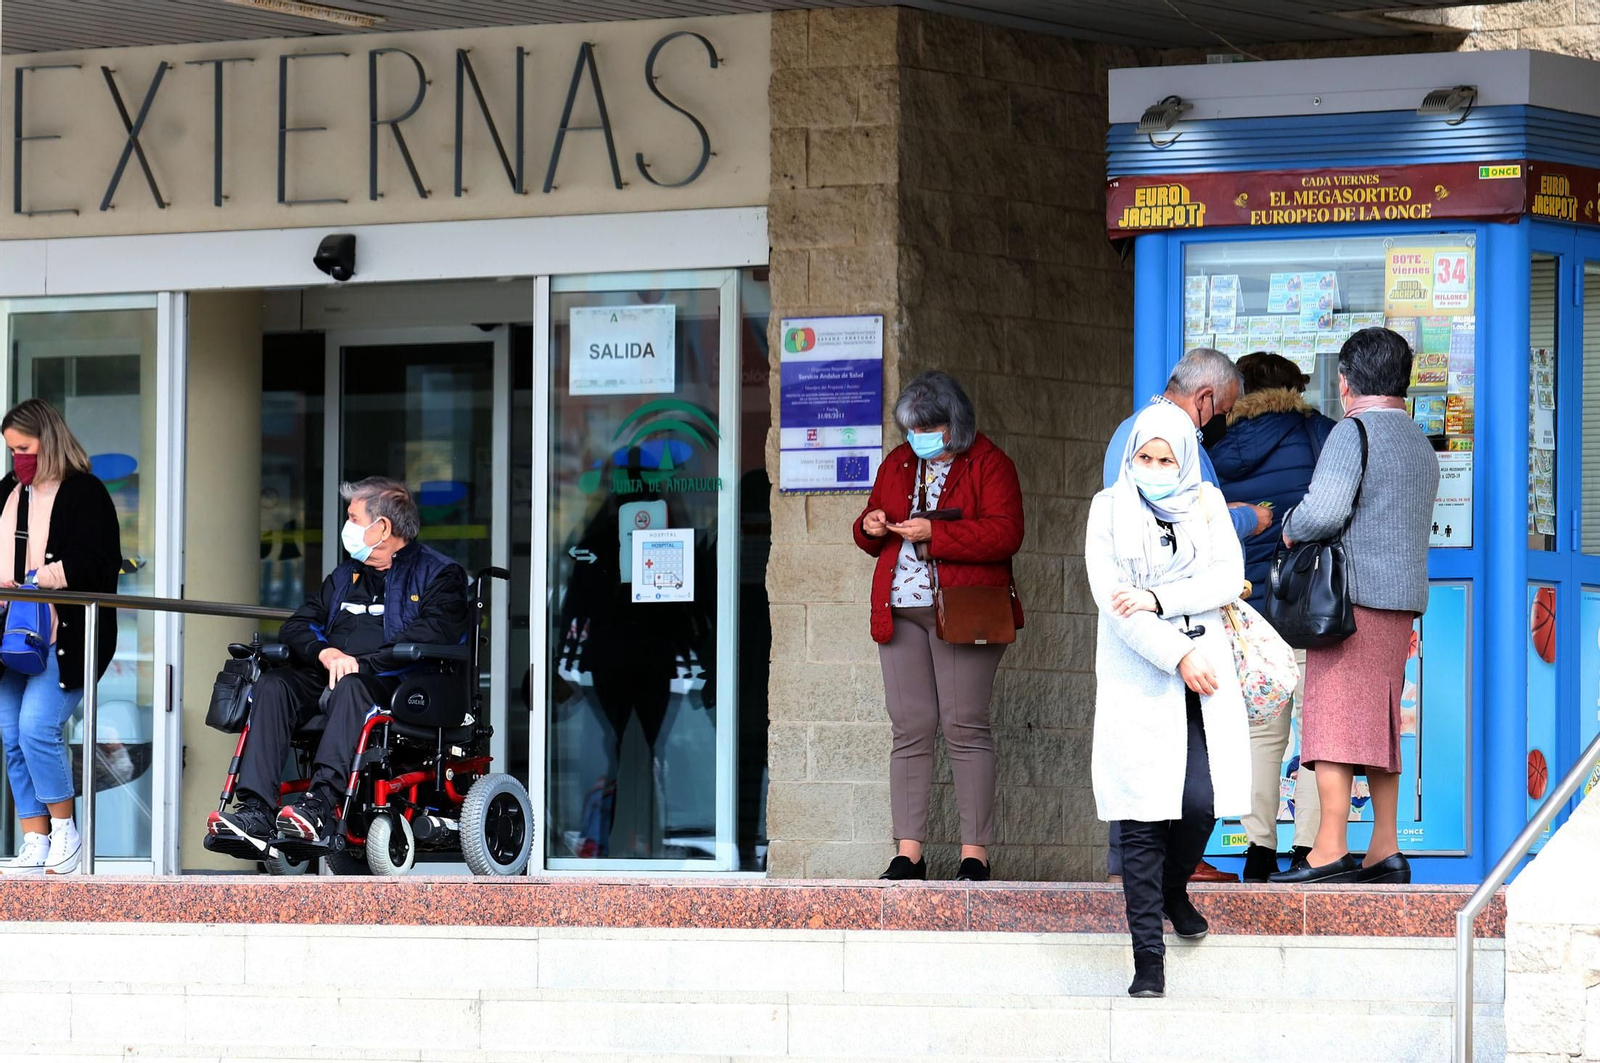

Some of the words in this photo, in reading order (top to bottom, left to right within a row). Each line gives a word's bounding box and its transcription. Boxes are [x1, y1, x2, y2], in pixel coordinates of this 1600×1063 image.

[14, 32, 723, 216] EXTERNAS
[1302, 177, 1331, 187] CADA
[1334, 174, 1380, 186] VIERNES
[1491, 167, 1518, 176] ONCE
[1135, 184, 1187, 207] EURO
[1270, 191, 1290, 207] EL
[1293, 186, 1412, 206] MEGASORTEO
[1541, 175, 1568, 197] EURO
[1118, 203, 1204, 228] JACKPOT
[1250, 207, 1330, 225] EUROPEO
[1333, 206, 1355, 222] DE
[1359, 205, 1381, 221] LA
[1384, 203, 1432, 220] ONCE
[1532, 194, 1578, 221] JACKPOT
[1392, 266, 1430, 274] viernes
[1393, 255, 1421, 264] BOTE
[1437, 258, 1466, 283] 34
[589, 343, 655, 359] SALIDA
[610, 479, 643, 493] JUNTA
[649, 478, 660, 492] DE
[667, 477, 724, 492] ANDALUCIA
[1231, 836, 1248, 844] ONC
